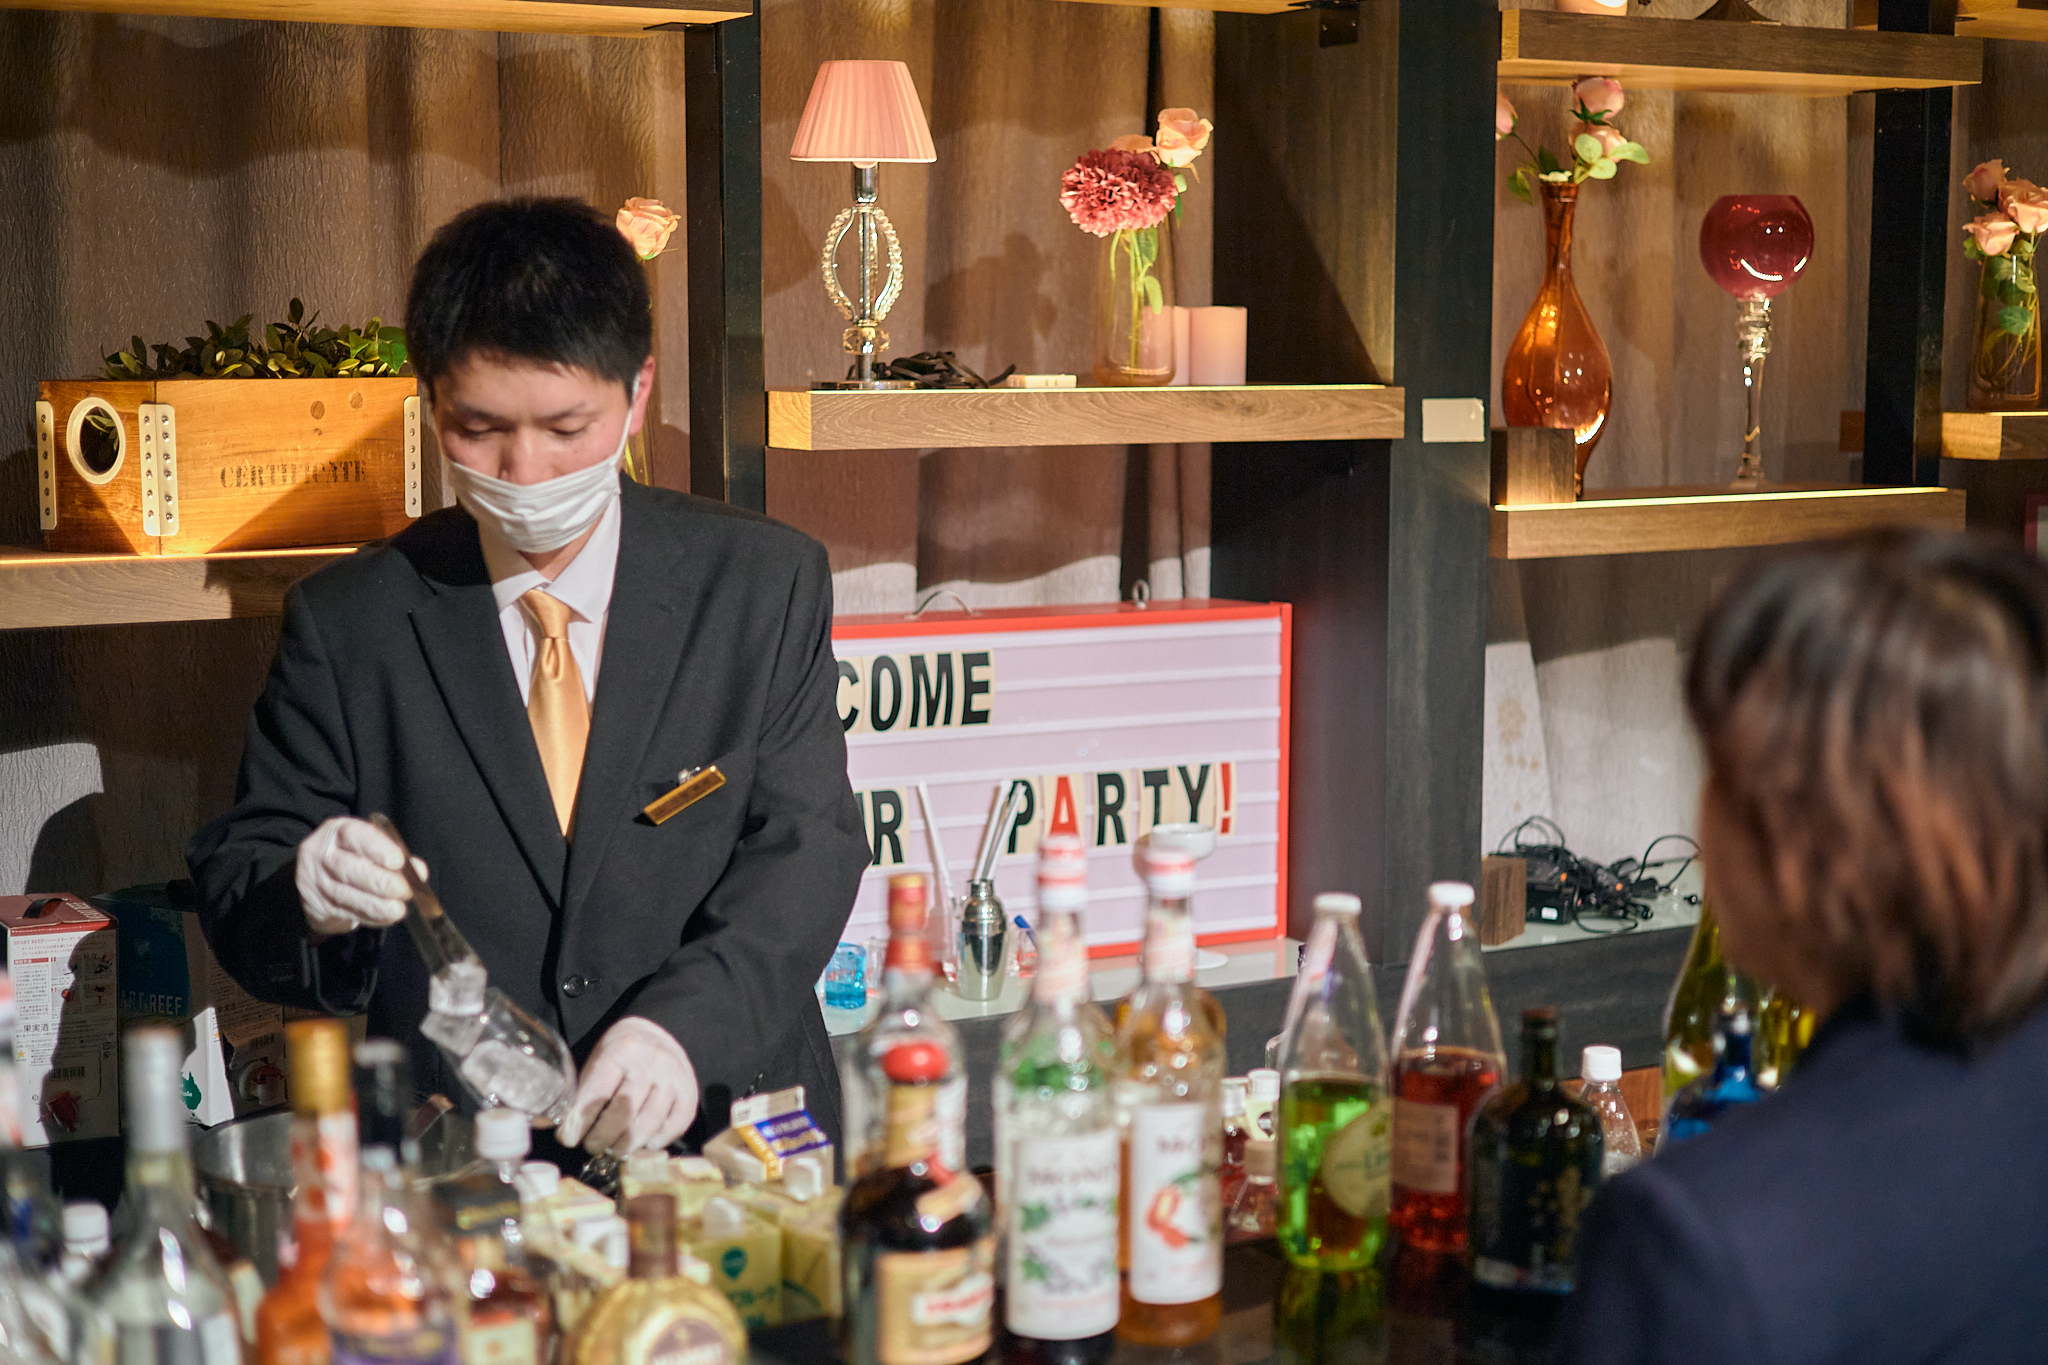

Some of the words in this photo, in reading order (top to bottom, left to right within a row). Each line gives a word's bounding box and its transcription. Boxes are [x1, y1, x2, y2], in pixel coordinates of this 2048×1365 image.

[1006, 762, 1232, 854] PARTY!
[149, 993, 183, 1016] REEF
[23, 1023, 49, 1033] 果実酒
